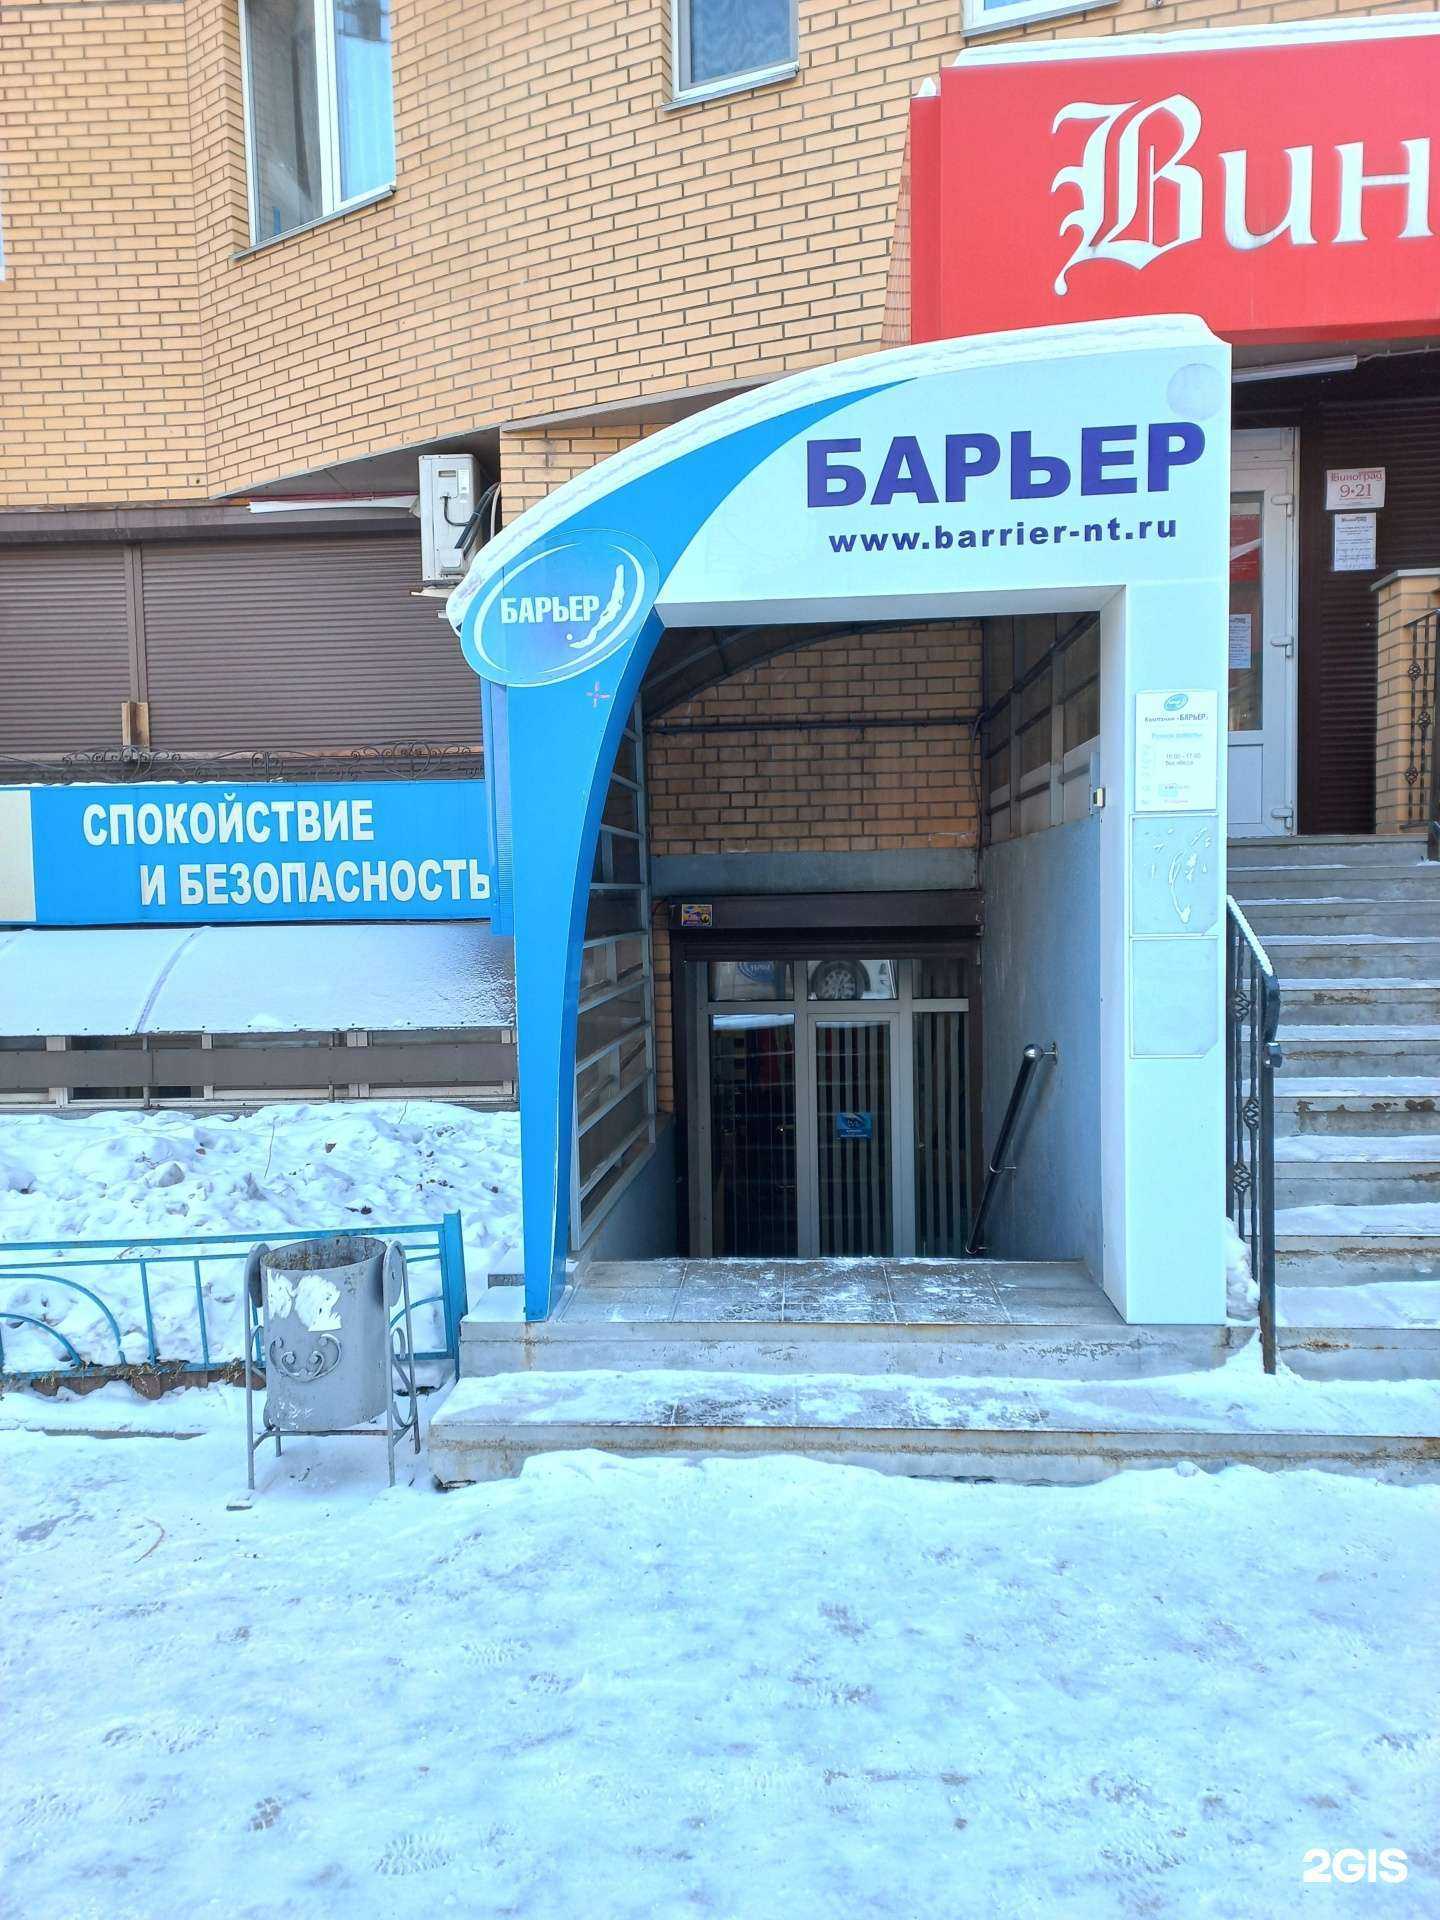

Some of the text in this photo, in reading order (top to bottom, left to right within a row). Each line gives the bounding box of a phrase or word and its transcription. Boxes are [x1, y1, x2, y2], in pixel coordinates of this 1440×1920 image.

[1051, 93, 1434, 296] Вин
[807, 421, 1206, 508] БАРЬЕР
[829, 517, 1177, 552] www.barrier-nt.ru
[501, 595, 600, 624] БАРЬЕР
[83, 792, 374, 846] СПОКОЙСТВИЕ
[140, 859, 491, 906] И БЕЗОПАСНОСТЬ
